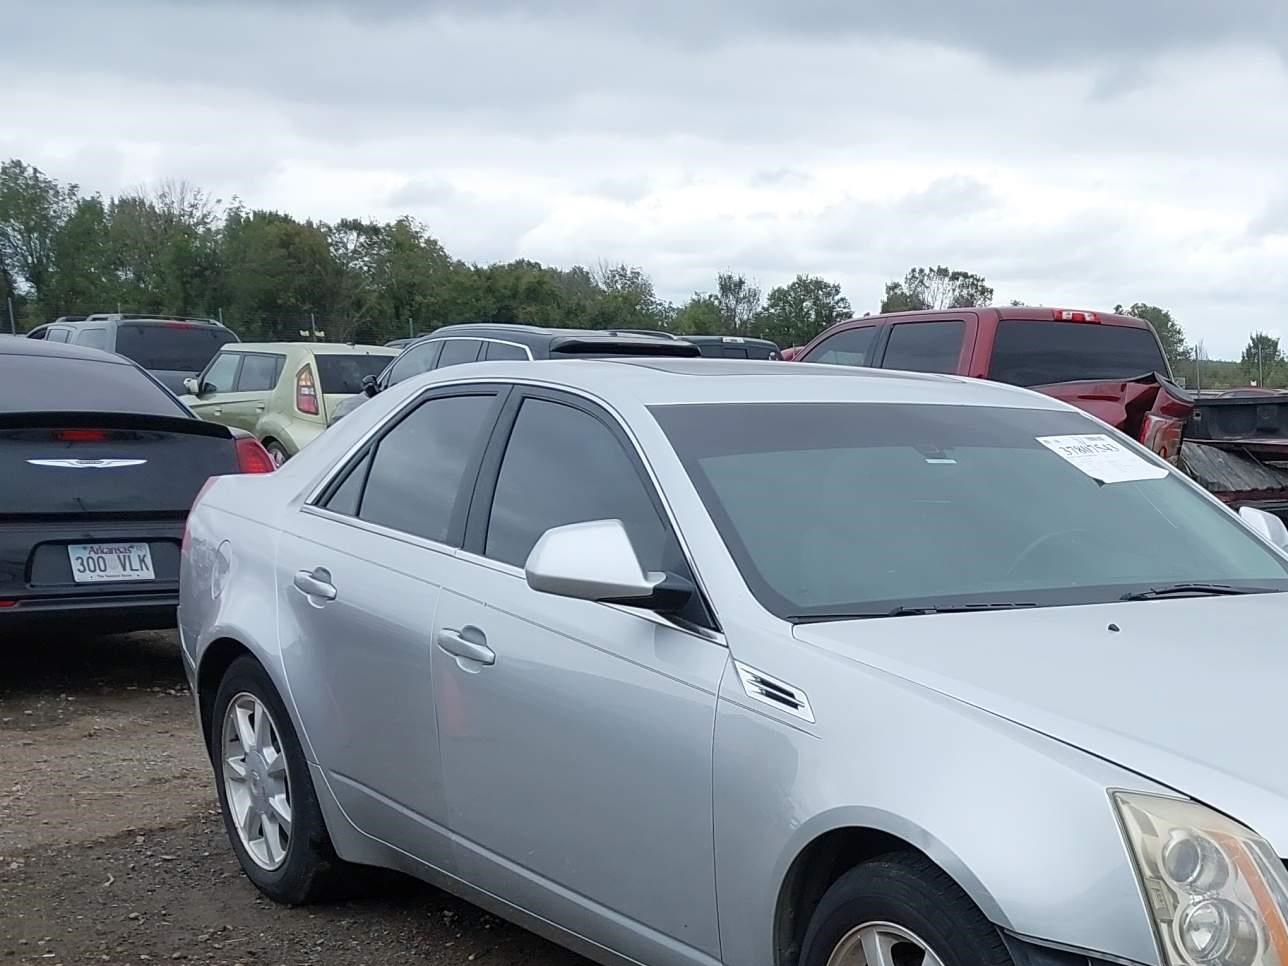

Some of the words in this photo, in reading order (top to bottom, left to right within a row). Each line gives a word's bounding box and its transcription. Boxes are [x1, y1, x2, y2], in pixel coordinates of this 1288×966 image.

[88, 545, 133, 555] Arkansas
[75, 556, 107, 573] 300
[117, 554, 149, 572] VLK
